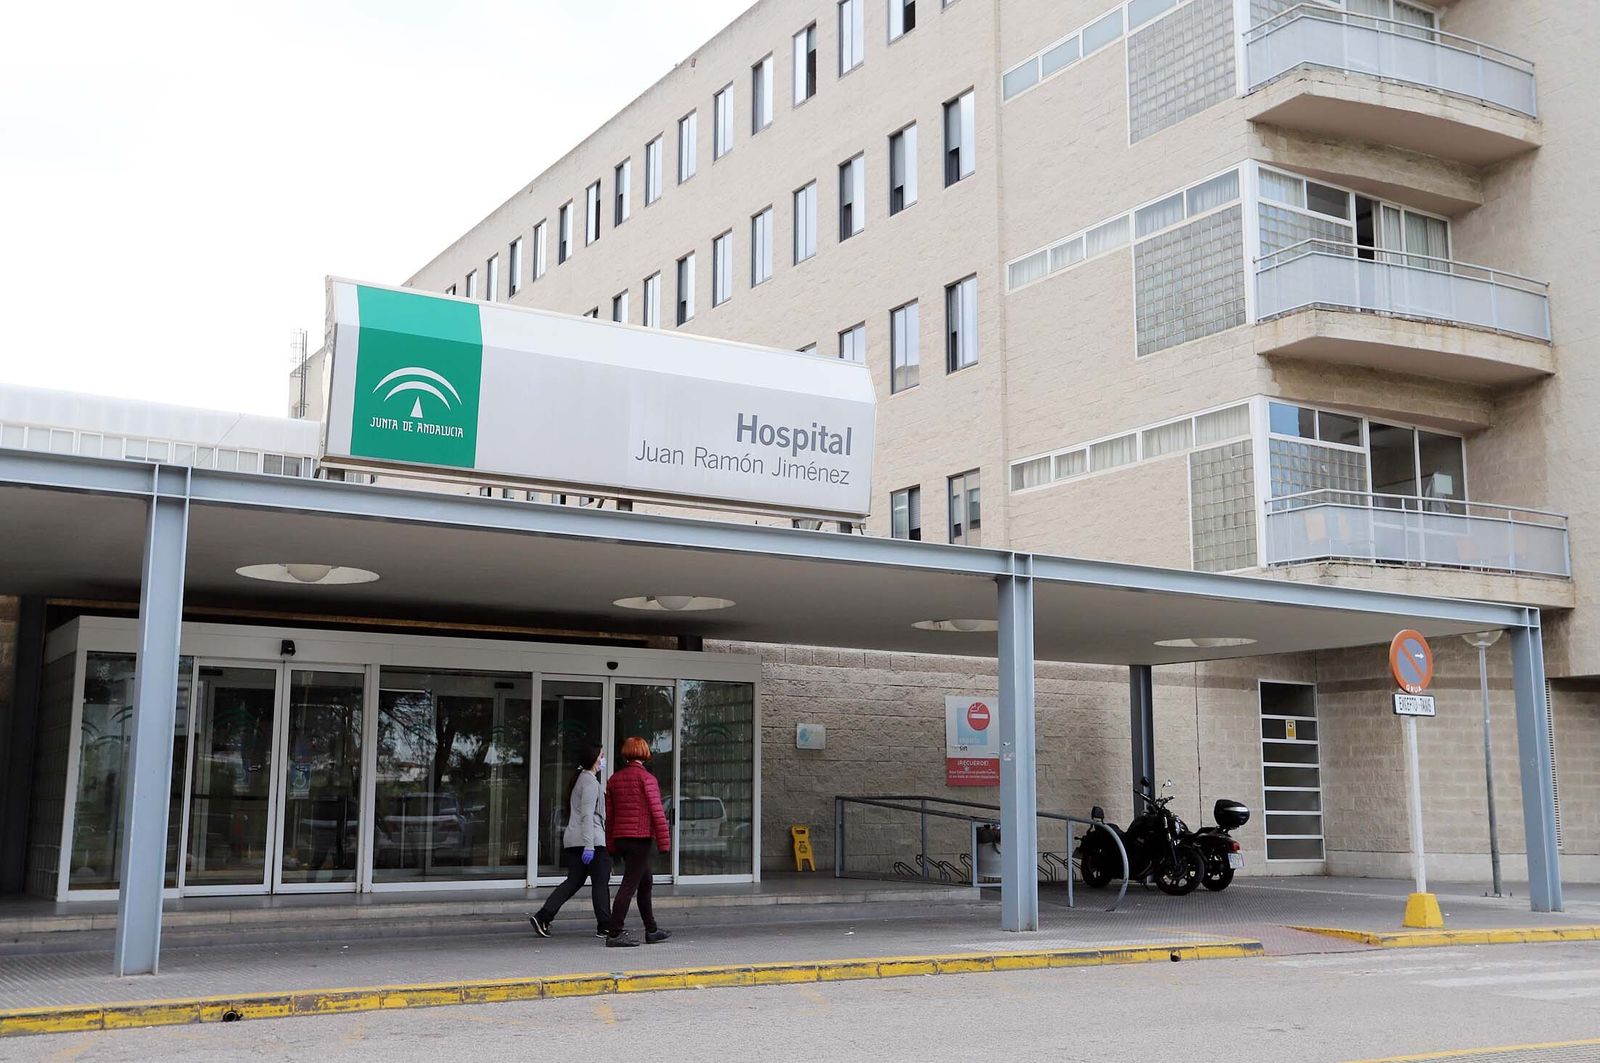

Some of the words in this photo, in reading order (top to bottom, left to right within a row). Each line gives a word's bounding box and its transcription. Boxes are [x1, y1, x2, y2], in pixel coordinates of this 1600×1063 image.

[370, 417, 398, 430] JUNTA
[402, 420, 414, 432] DE
[417, 422, 464, 438] ANDALUCIA
[736, 412, 852, 457] Hospital
[635, 440, 684, 465] Juan
[694, 446, 764, 474] Ramón
[771, 456, 850, 485] Jiménez
